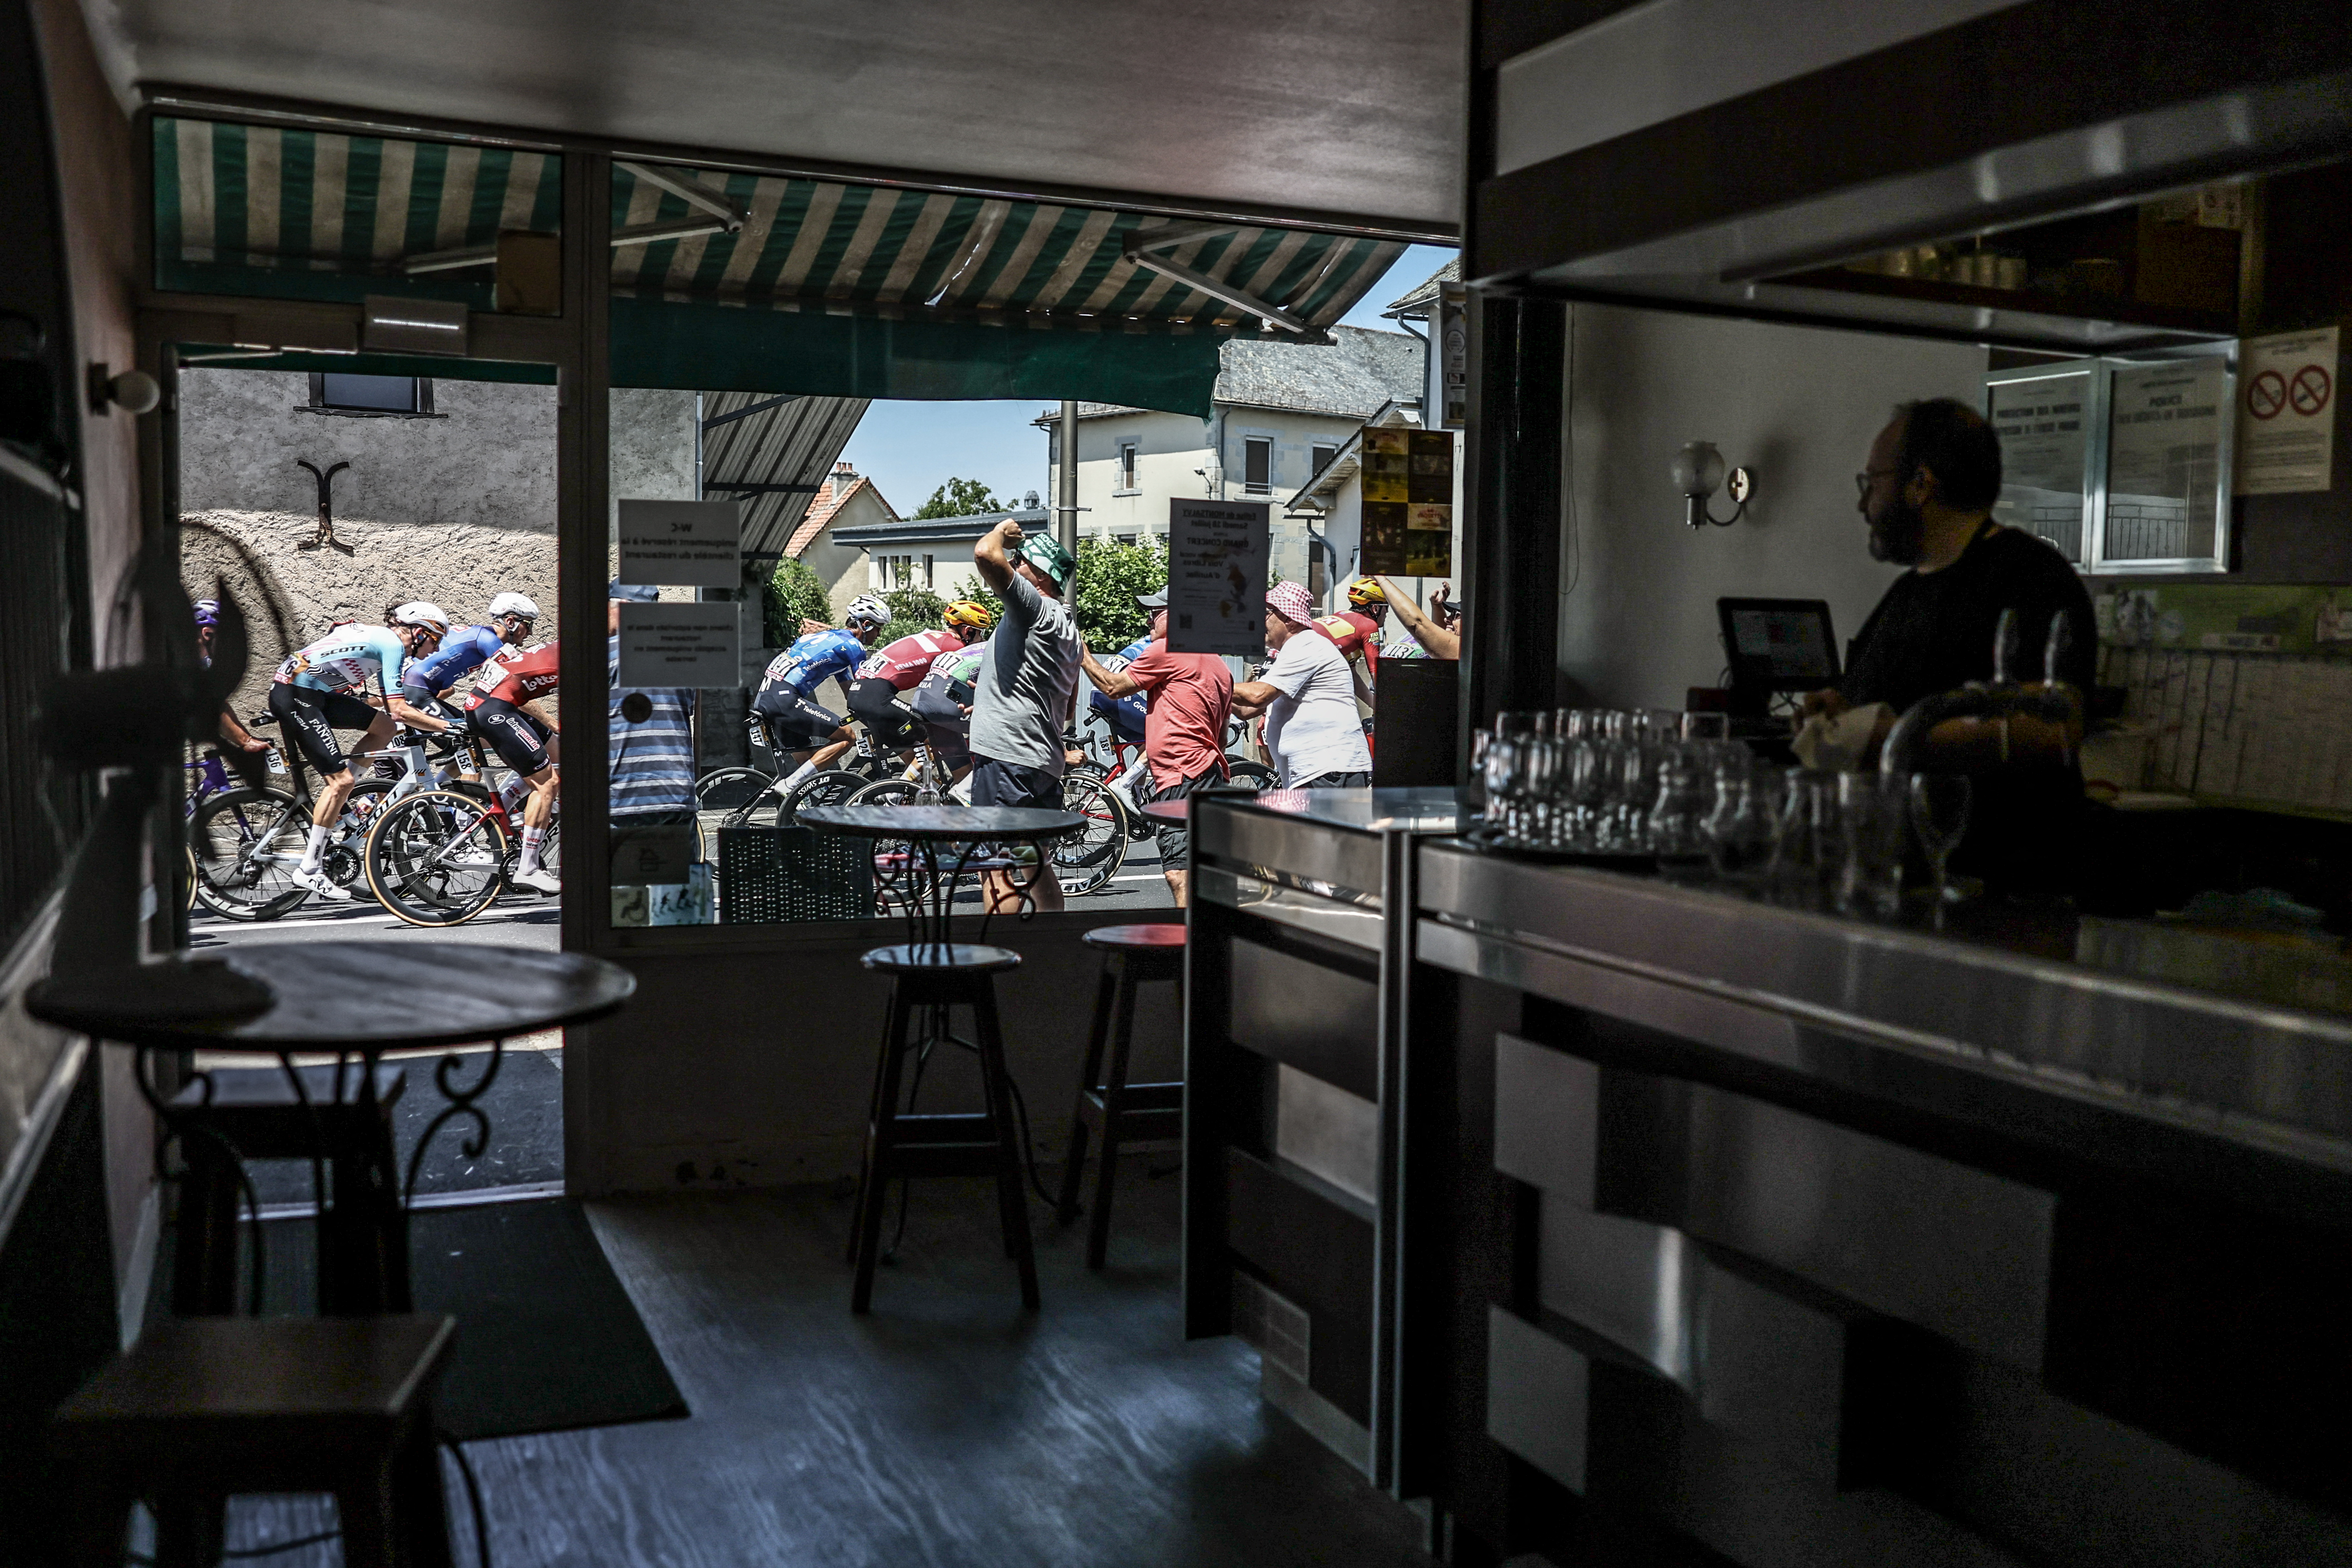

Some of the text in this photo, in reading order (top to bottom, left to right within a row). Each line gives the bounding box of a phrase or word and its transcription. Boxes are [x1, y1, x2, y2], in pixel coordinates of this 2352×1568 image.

[1041, 544, 1055, 558] Cycling
[320, 646, 366, 658] SCOTT
[1388, 646, 1409, 658] 113
[802, 657, 832, 672] Telefónica
[894, 657, 928, 671] REMA 1000
[936, 653, 961, 671] 117
[522, 675, 558, 691] Lotto
[891, 698, 911, 712] REMA
[290, 711, 309, 730] NSN
[803, 705, 832, 722] Telefónica
[309, 718, 339, 756] FANTINI
[323, 723, 336, 744] CANTINA
[750, 730, 763, 743] 147
[858, 739, 869, 754] 124
[1100, 738, 1110, 752] 187
[266, 751, 282, 768] 136
[456, 752, 472, 769] 158
[798, 780, 817, 797] SWISS
[357, 788, 399, 840] SCOTT
